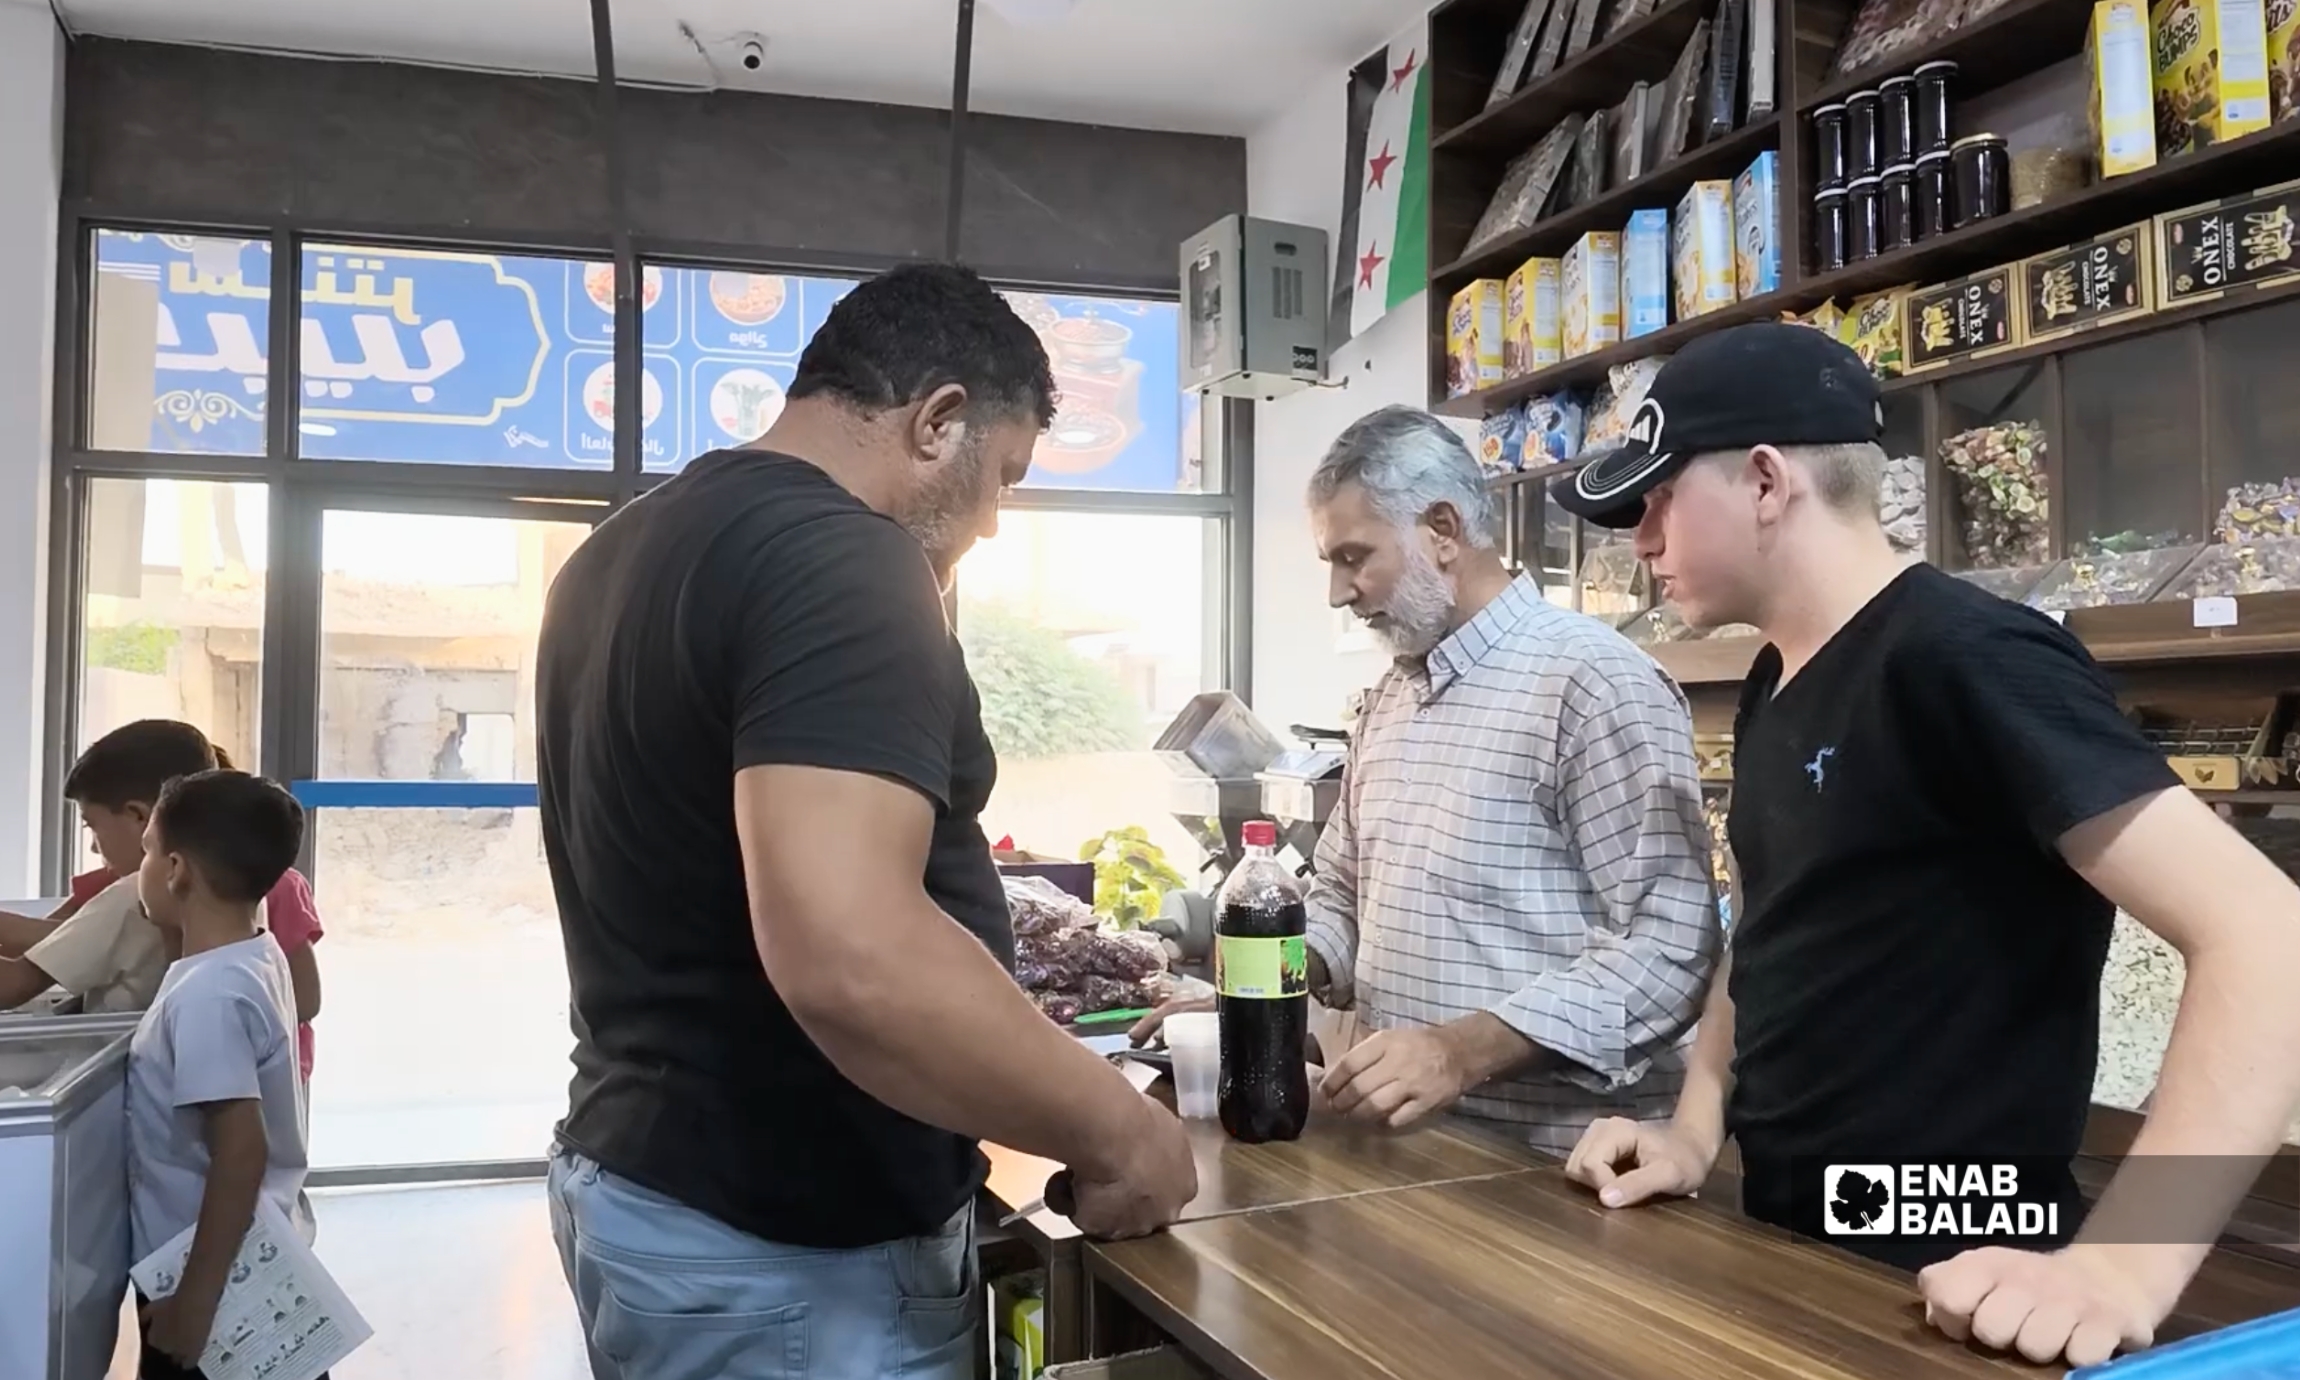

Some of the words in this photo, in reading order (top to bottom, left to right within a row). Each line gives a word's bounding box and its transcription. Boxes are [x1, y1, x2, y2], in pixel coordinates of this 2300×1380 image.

[2202, 216, 2221, 285] ONEX
[2225, 222, 2236, 270] CHOCOLATE
[2082, 261, 2091, 305] CHOCOLATE
[2094, 246, 2111, 311] ONEX
[1968, 285, 1983, 345] ONEX
